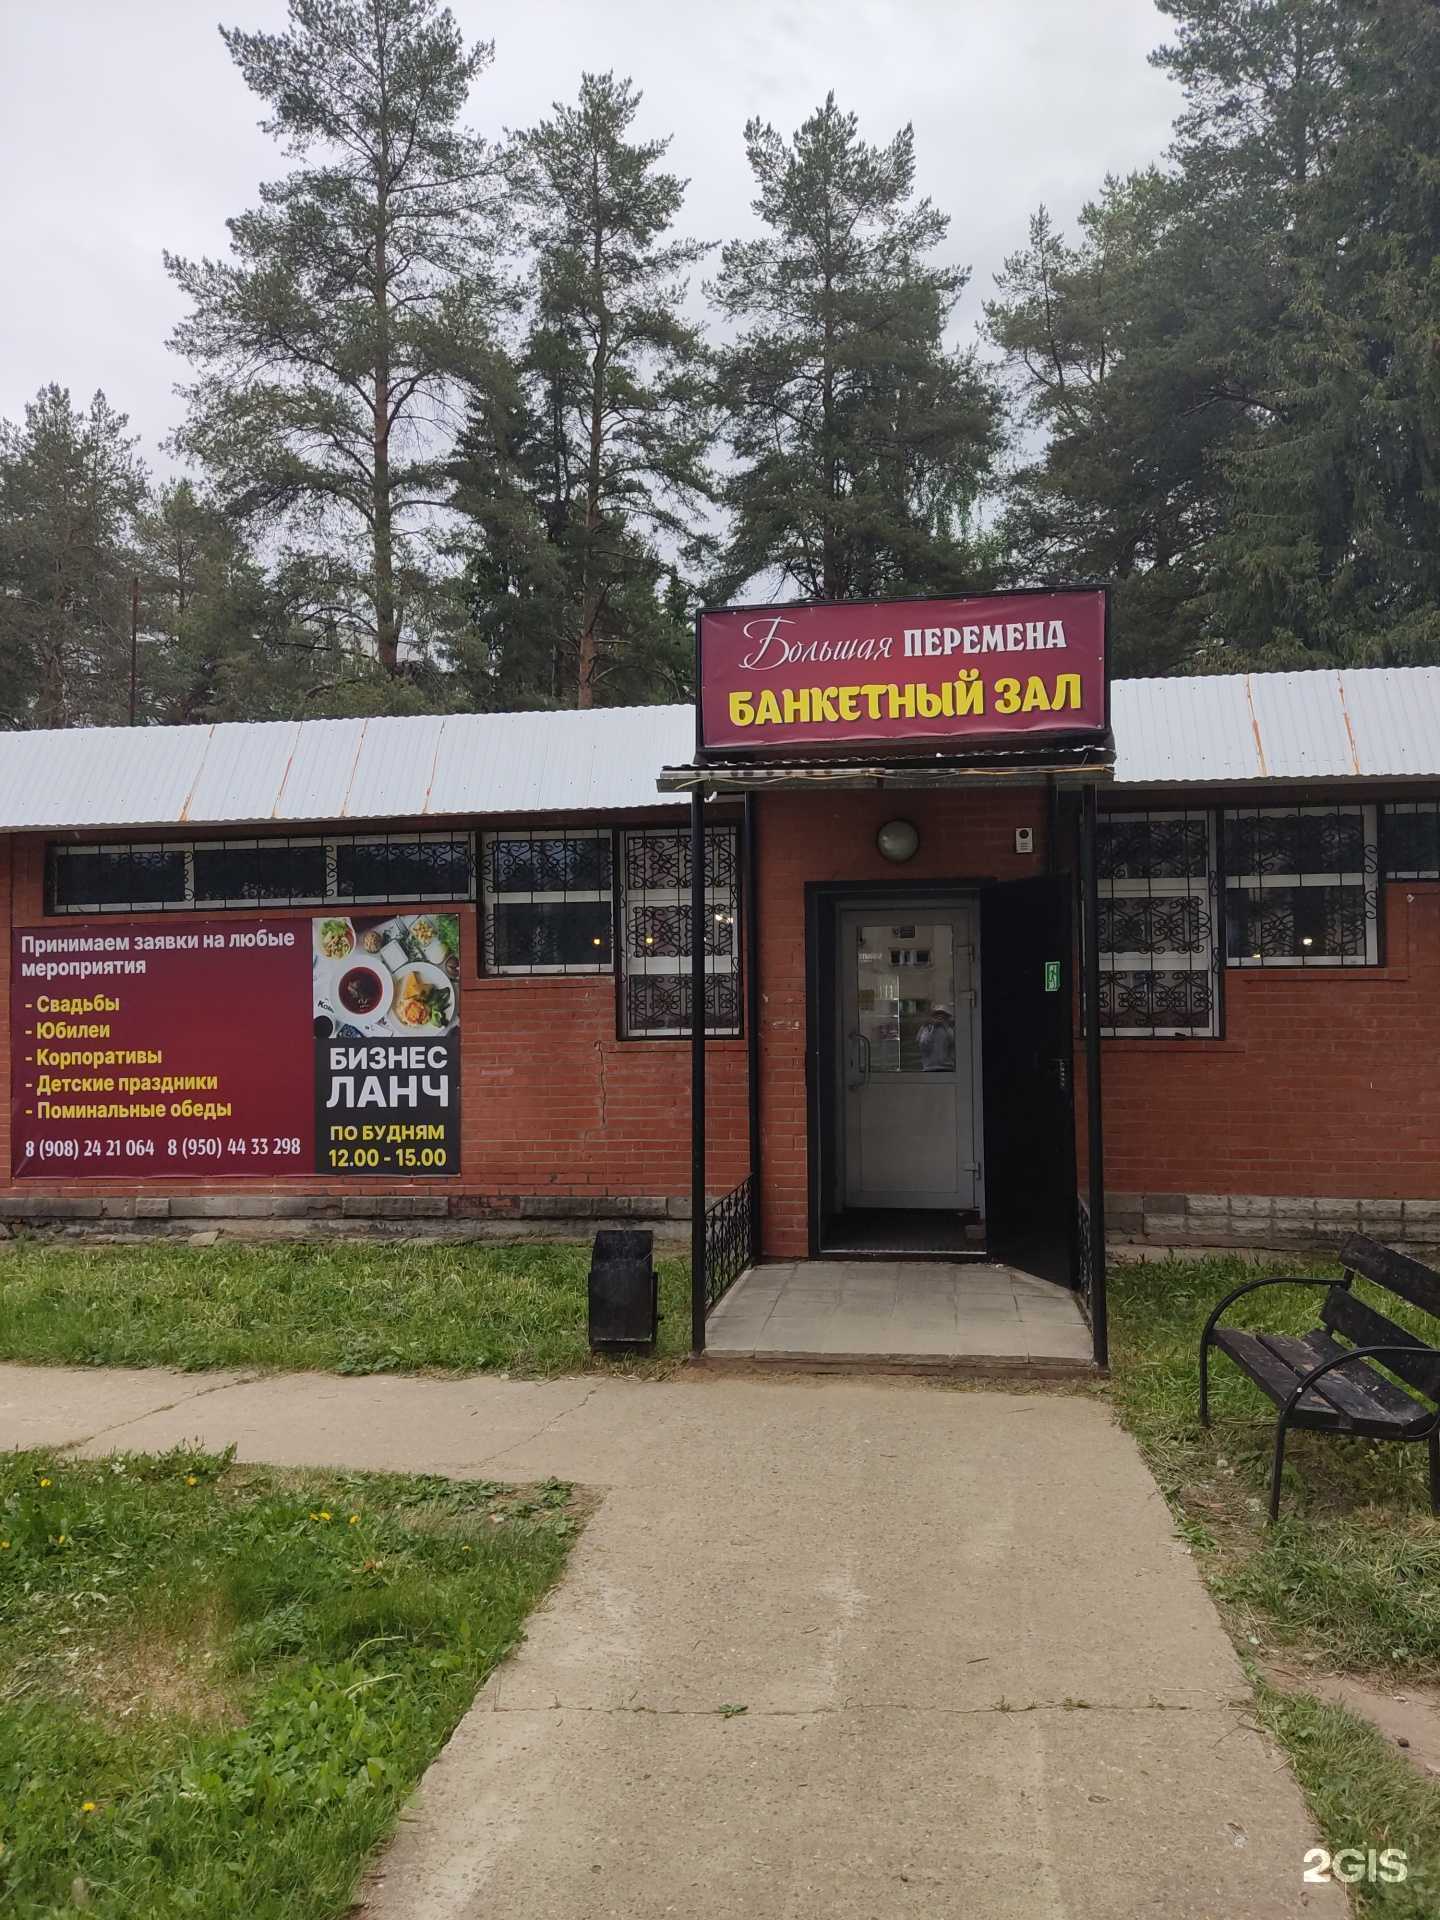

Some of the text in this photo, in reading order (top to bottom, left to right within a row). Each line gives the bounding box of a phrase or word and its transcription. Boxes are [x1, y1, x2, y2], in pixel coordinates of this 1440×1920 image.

[738, 615, 1066, 670] Большая ПЕРЕМЕНА
[728, 667, 1080, 726] БАНКЕТНЫЙ ЗАЛ
[21, 928, 294, 957] Принимаем заявки на любые
[21, 959, 145, 980] мероприятия
[36, 993, 119, 1015] Свадьбы
[36, 1021, 110, 1039] Юбилеи
[36, 1048, 161, 1069] Корпоративы
[329, 1045, 447, 1069] БИЗНЕС
[36, 1074, 114, 1096] Детские
[118, 1075, 217, 1095] праздники
[326, 1074, 448, 1107] ЛАНЧ
[37, 1101, 166, 1118] Поминальные
[170, 1099, 231, 1120] обеды
[330, 1124, 444, 1143] ПО БУДНЯМ
[25, 1136, 300, 1160] 8 (908) 24 21 064 8 (950) 44 33 298
[328, 1148, 379, 1166] 12.00
[395, 1147, 446, 1166] 15.00
